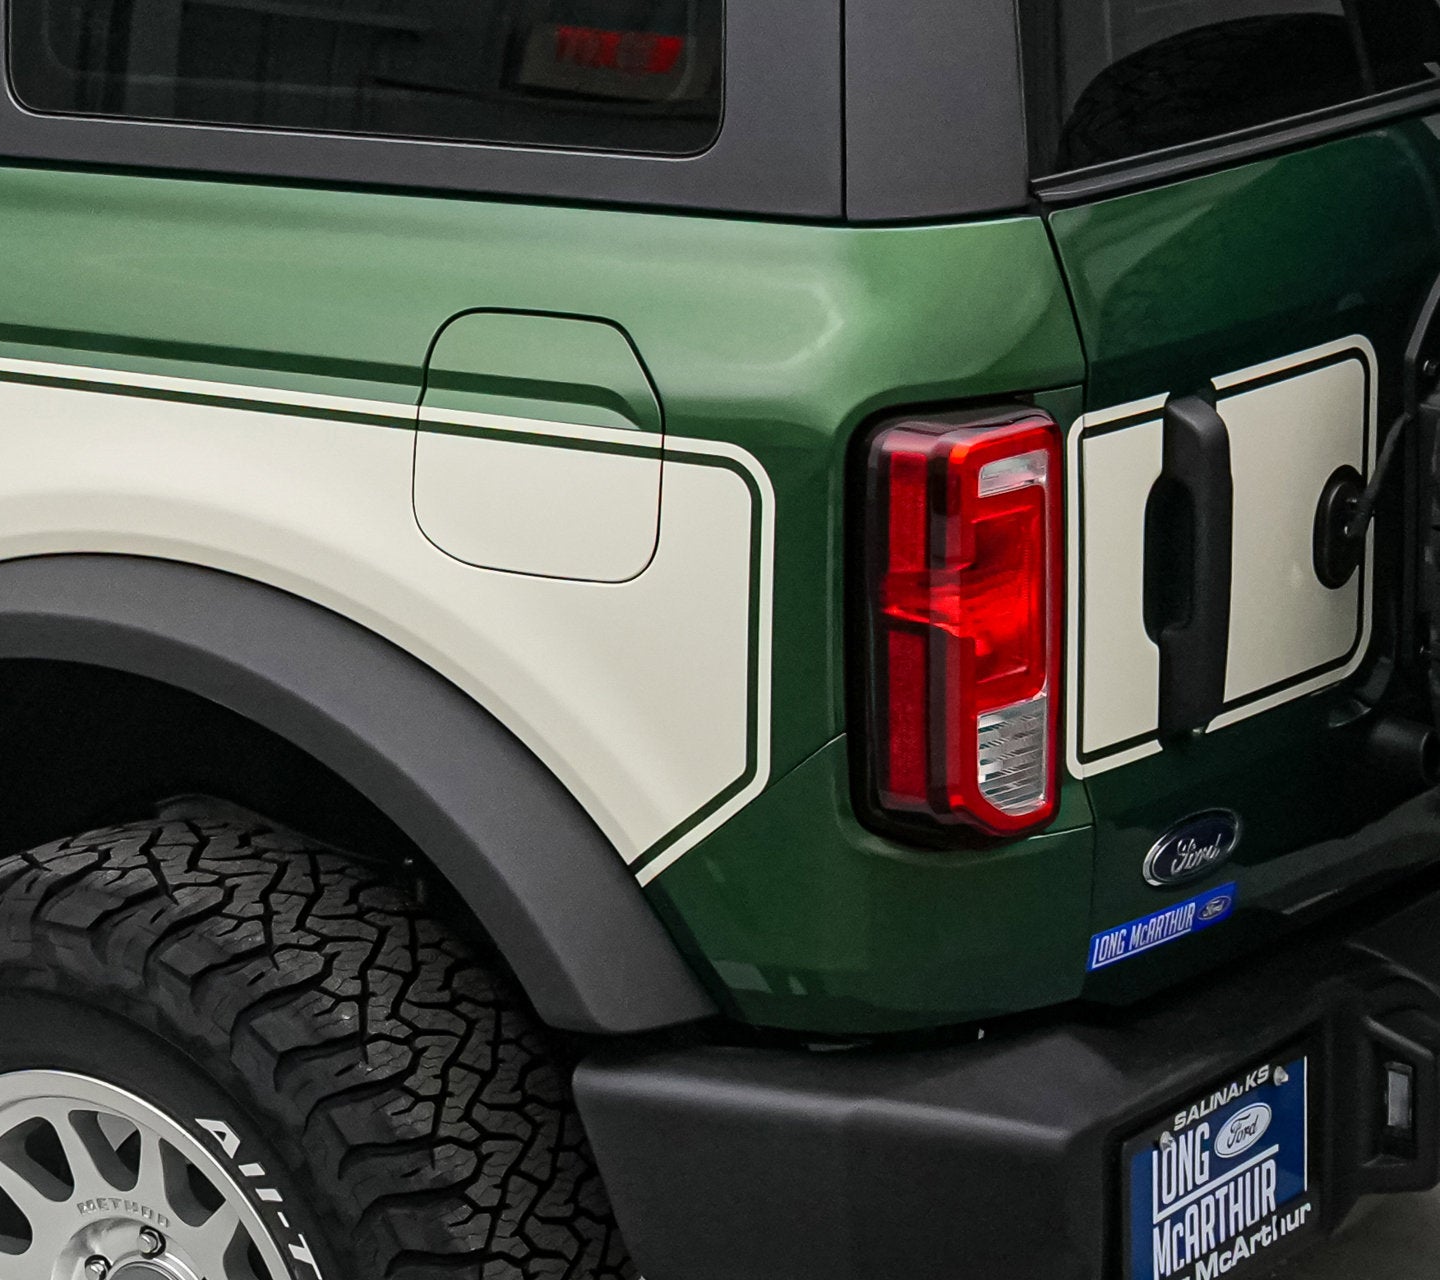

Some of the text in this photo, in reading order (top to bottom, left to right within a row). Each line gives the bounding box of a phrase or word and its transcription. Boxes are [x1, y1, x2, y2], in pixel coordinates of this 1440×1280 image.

[1170, 833, 1222, 875] Ford
[1092, 928, 1127, 969] LONG
[1128, 902, 1196, 951] McARTHUR
[1152, 1114, 1259, 1225] LONG Ford
